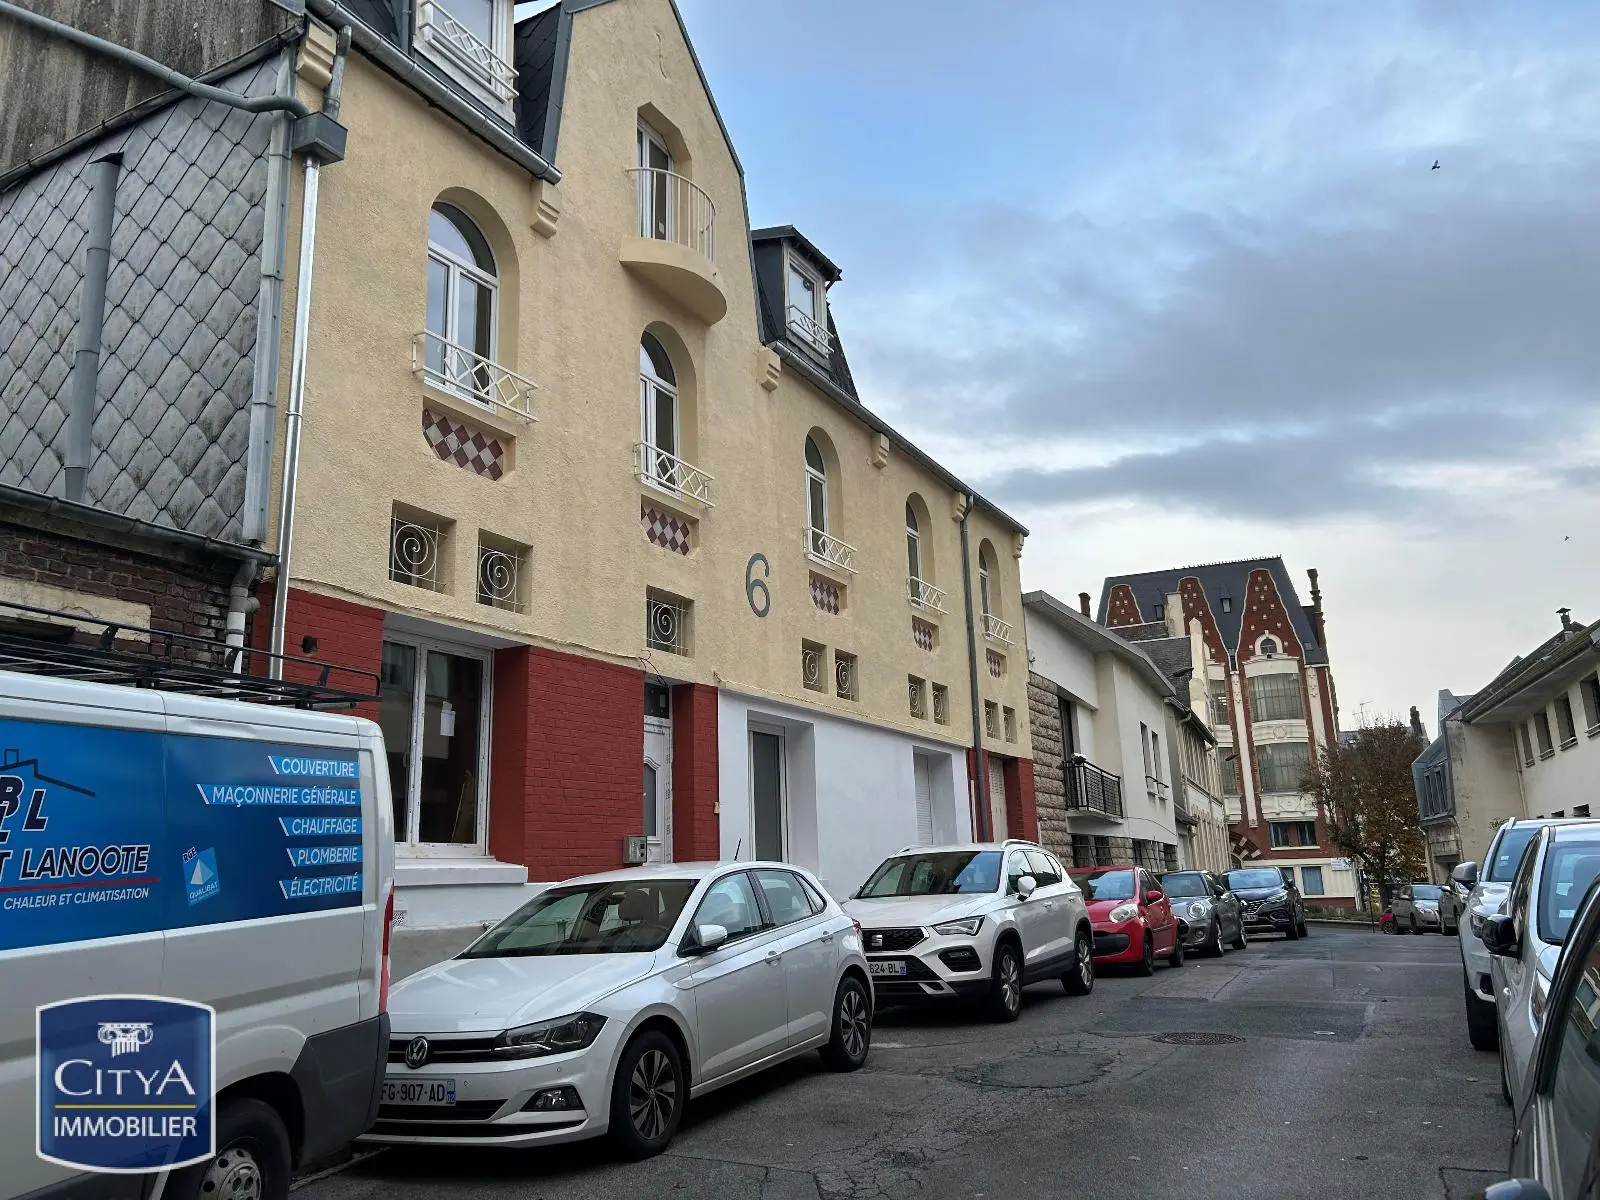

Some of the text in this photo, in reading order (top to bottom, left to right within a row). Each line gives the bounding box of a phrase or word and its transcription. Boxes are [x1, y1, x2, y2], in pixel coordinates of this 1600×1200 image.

[746, 552, 770, 617] 6
[281, 758, 355, 777] COUVERTURE
[212, 786, 356, 807] MAÇONNERIE GÉNÉRALE
[291, 818, 358, 834] CHAUFFAGE
[19, 844, 151, 880] LANOOTE
[297, 847, 358, 865] PLOMBERIE
[290, 872, 359, 897] ÉLECTRICITÉ
[3, 887, 149, 910] CHALEUR ET CLIMATISATION
